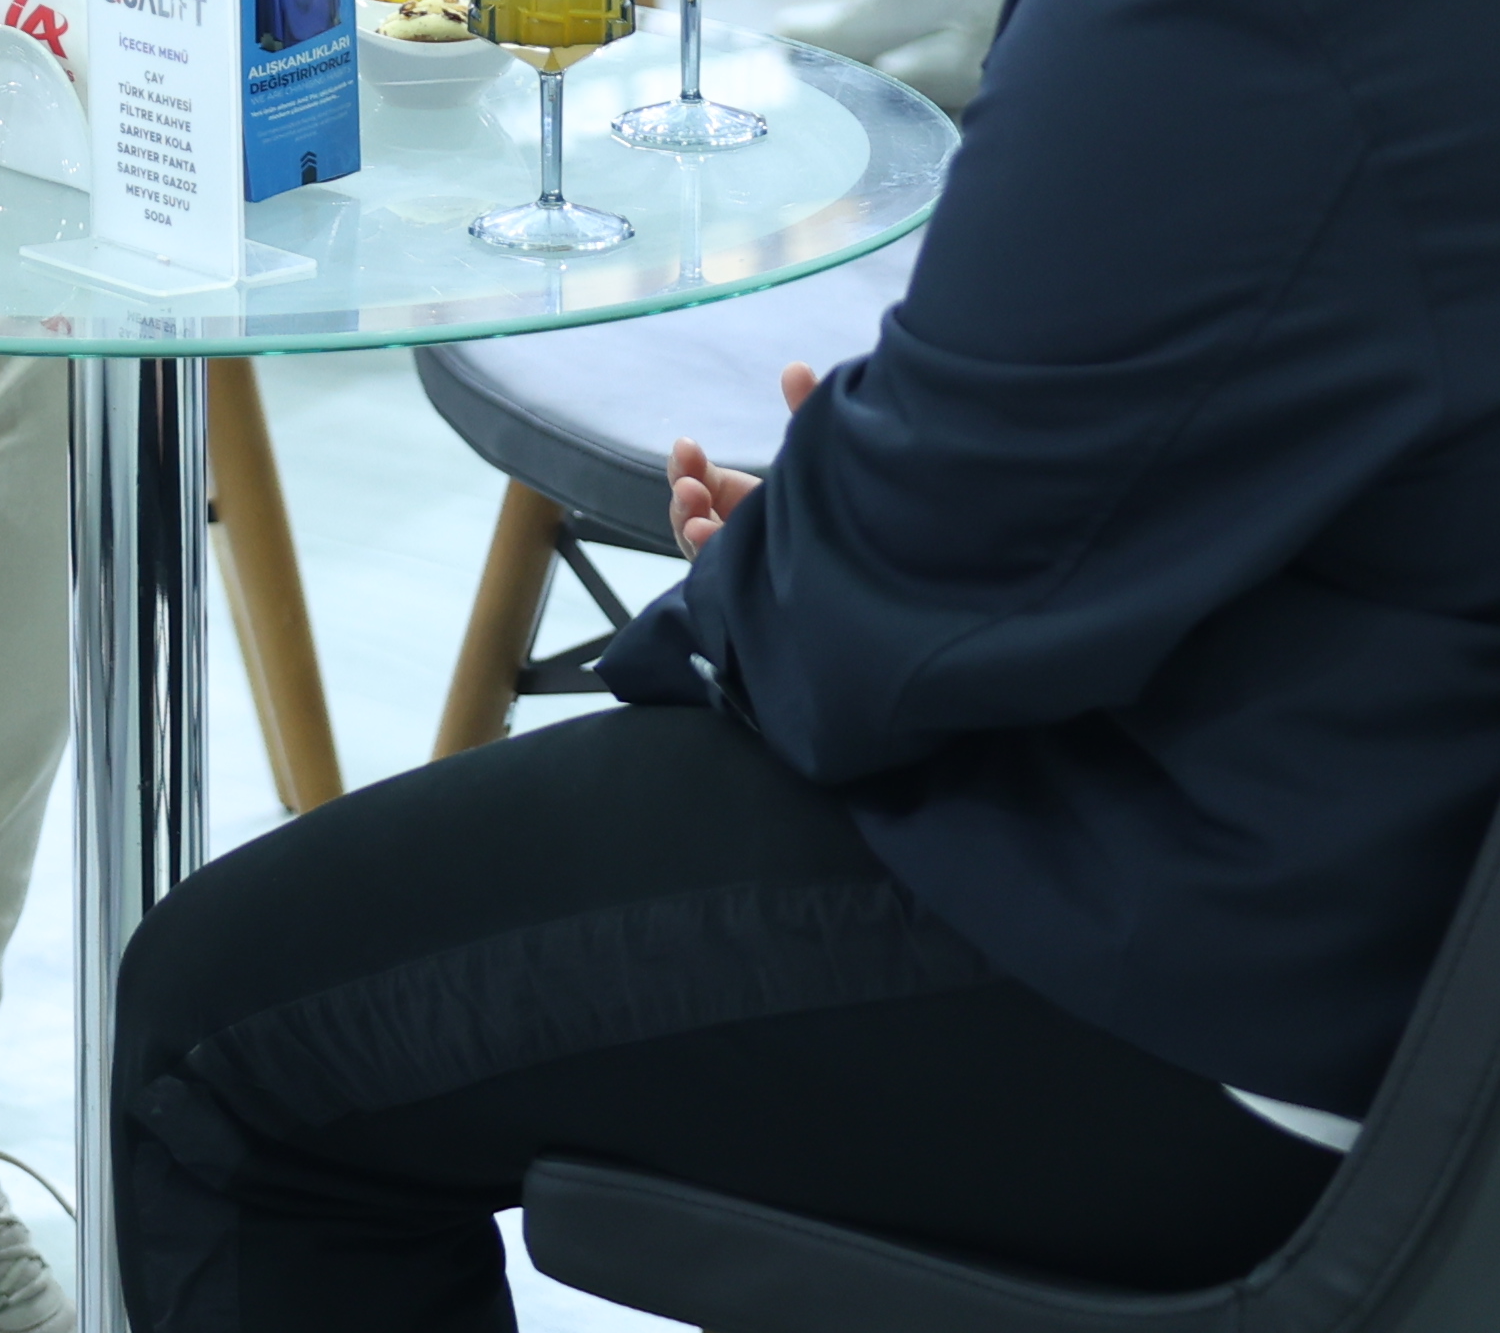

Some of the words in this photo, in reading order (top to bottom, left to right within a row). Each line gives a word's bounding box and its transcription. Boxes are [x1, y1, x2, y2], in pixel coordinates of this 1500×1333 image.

[118, 31, 156, 56] İÇECEK
[158, 46, 189, 65] MENÜ
[248, 35, 351, 80] ALIŞKANLIKLARI
[144, 70, 165, 85] ÇAY
[250, 51, 352, 95] DEĞİŞTİRİYORUZ
[118, 81, 146, 100] TÜRK
[147, 90, 192, 113] KAHVESİ
[119, 101, 153, 123] FİLTRE
[155, 113, 191, 133] KAHVE
[119, 122, 162, 145] SARIYER
[164, 134, 192, 153] KOLA
[117, 141, 160, 164] SARIYER
[162, 153, 196, 174] FANTA
[117, 161, 160, 183] SARIYER
[162, 174, 198, 194] GAZOZ
[125, 183, 160, 203] MEYVE
[162, 194, 190, 212] SUYU
[144, 208, 172, 227] SODA
